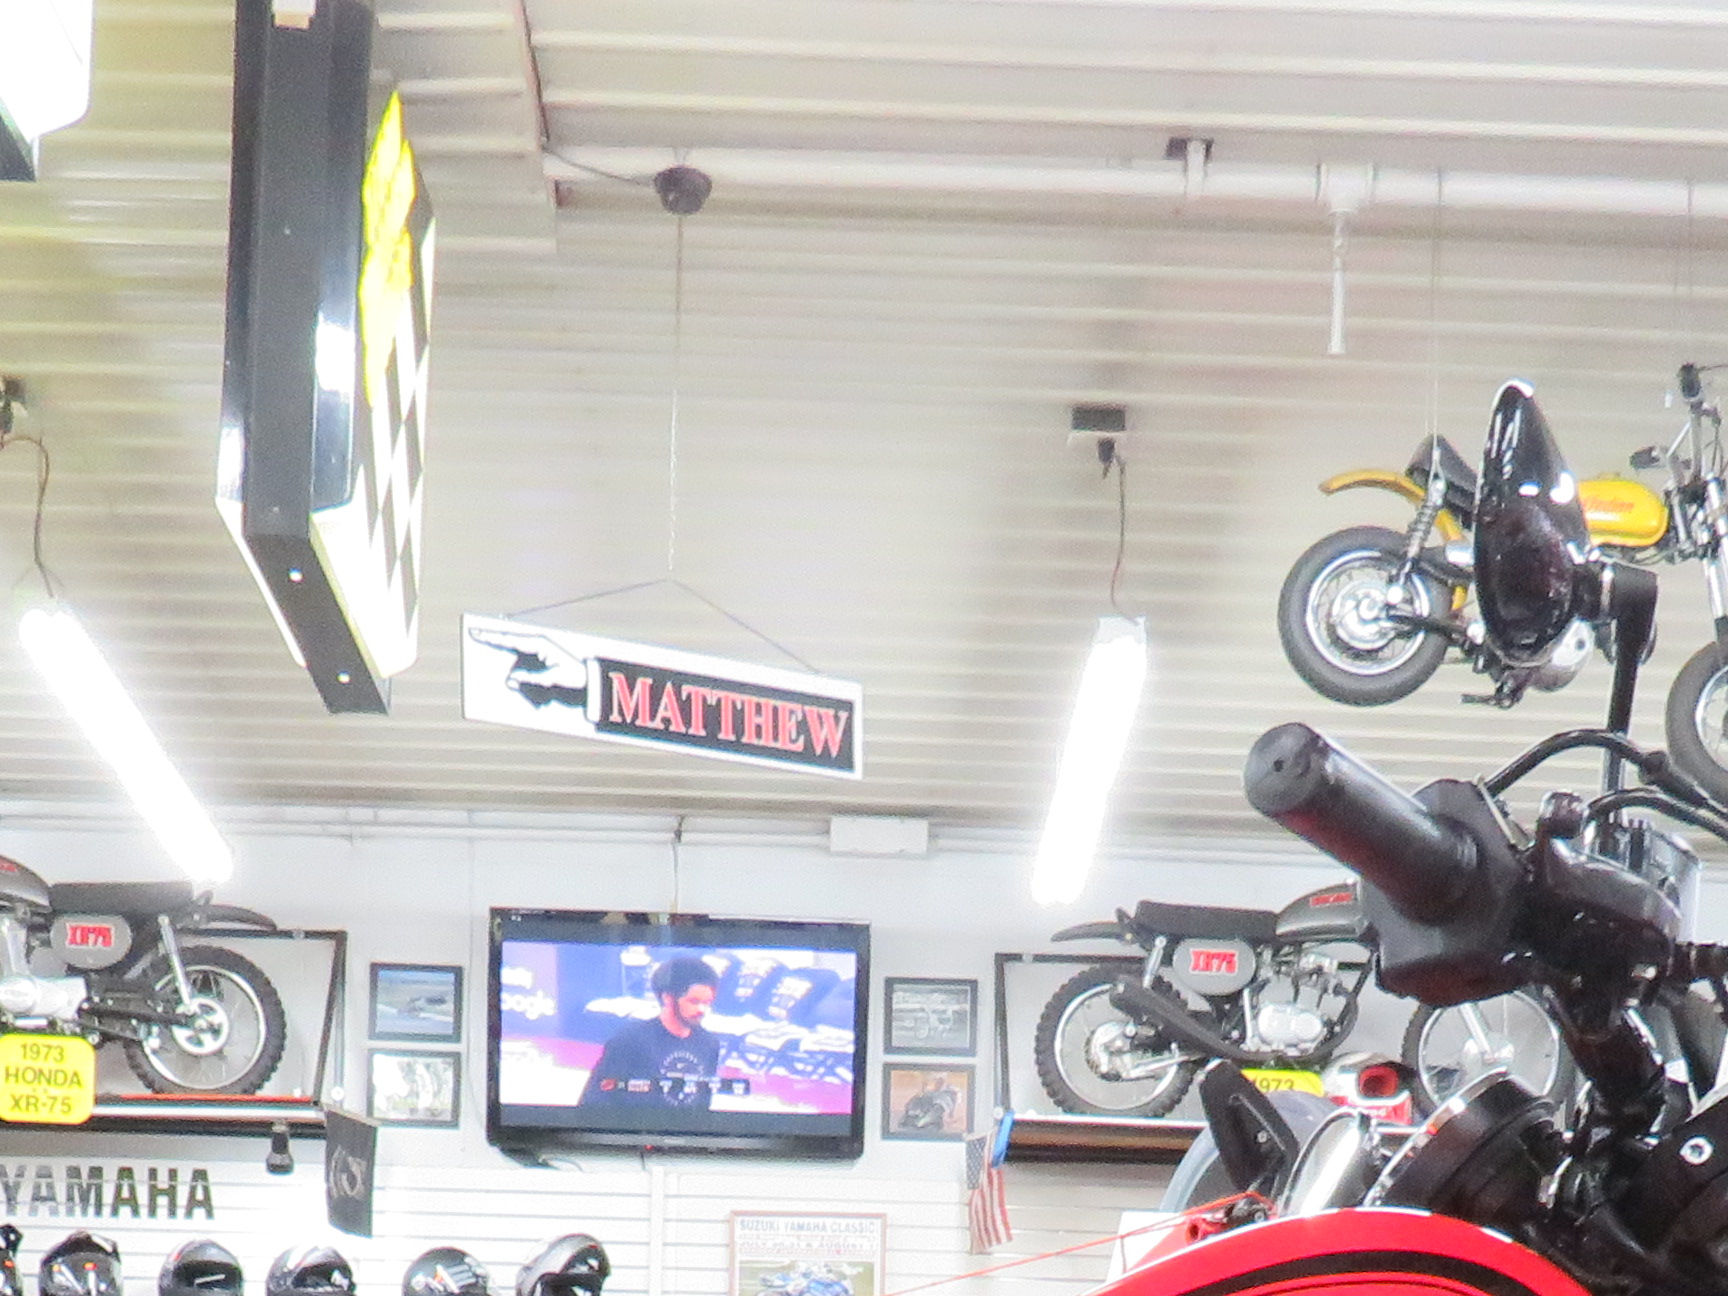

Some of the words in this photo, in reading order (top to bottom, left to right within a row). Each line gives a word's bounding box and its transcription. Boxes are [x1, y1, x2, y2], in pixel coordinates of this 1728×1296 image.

[608, 671, 850, 759] MATTHEW
[20, 1043, 65, 1062] 1973
[4, 1066, 84, 1089] HONDA
[9, 1094, 73, 1115] XR-75
[740, 1219, 780, 1232] SUZUKI
[784, 1220, 827, 1233] YAMAHA
[830, 1221, 875, 1234] CLASSIC
